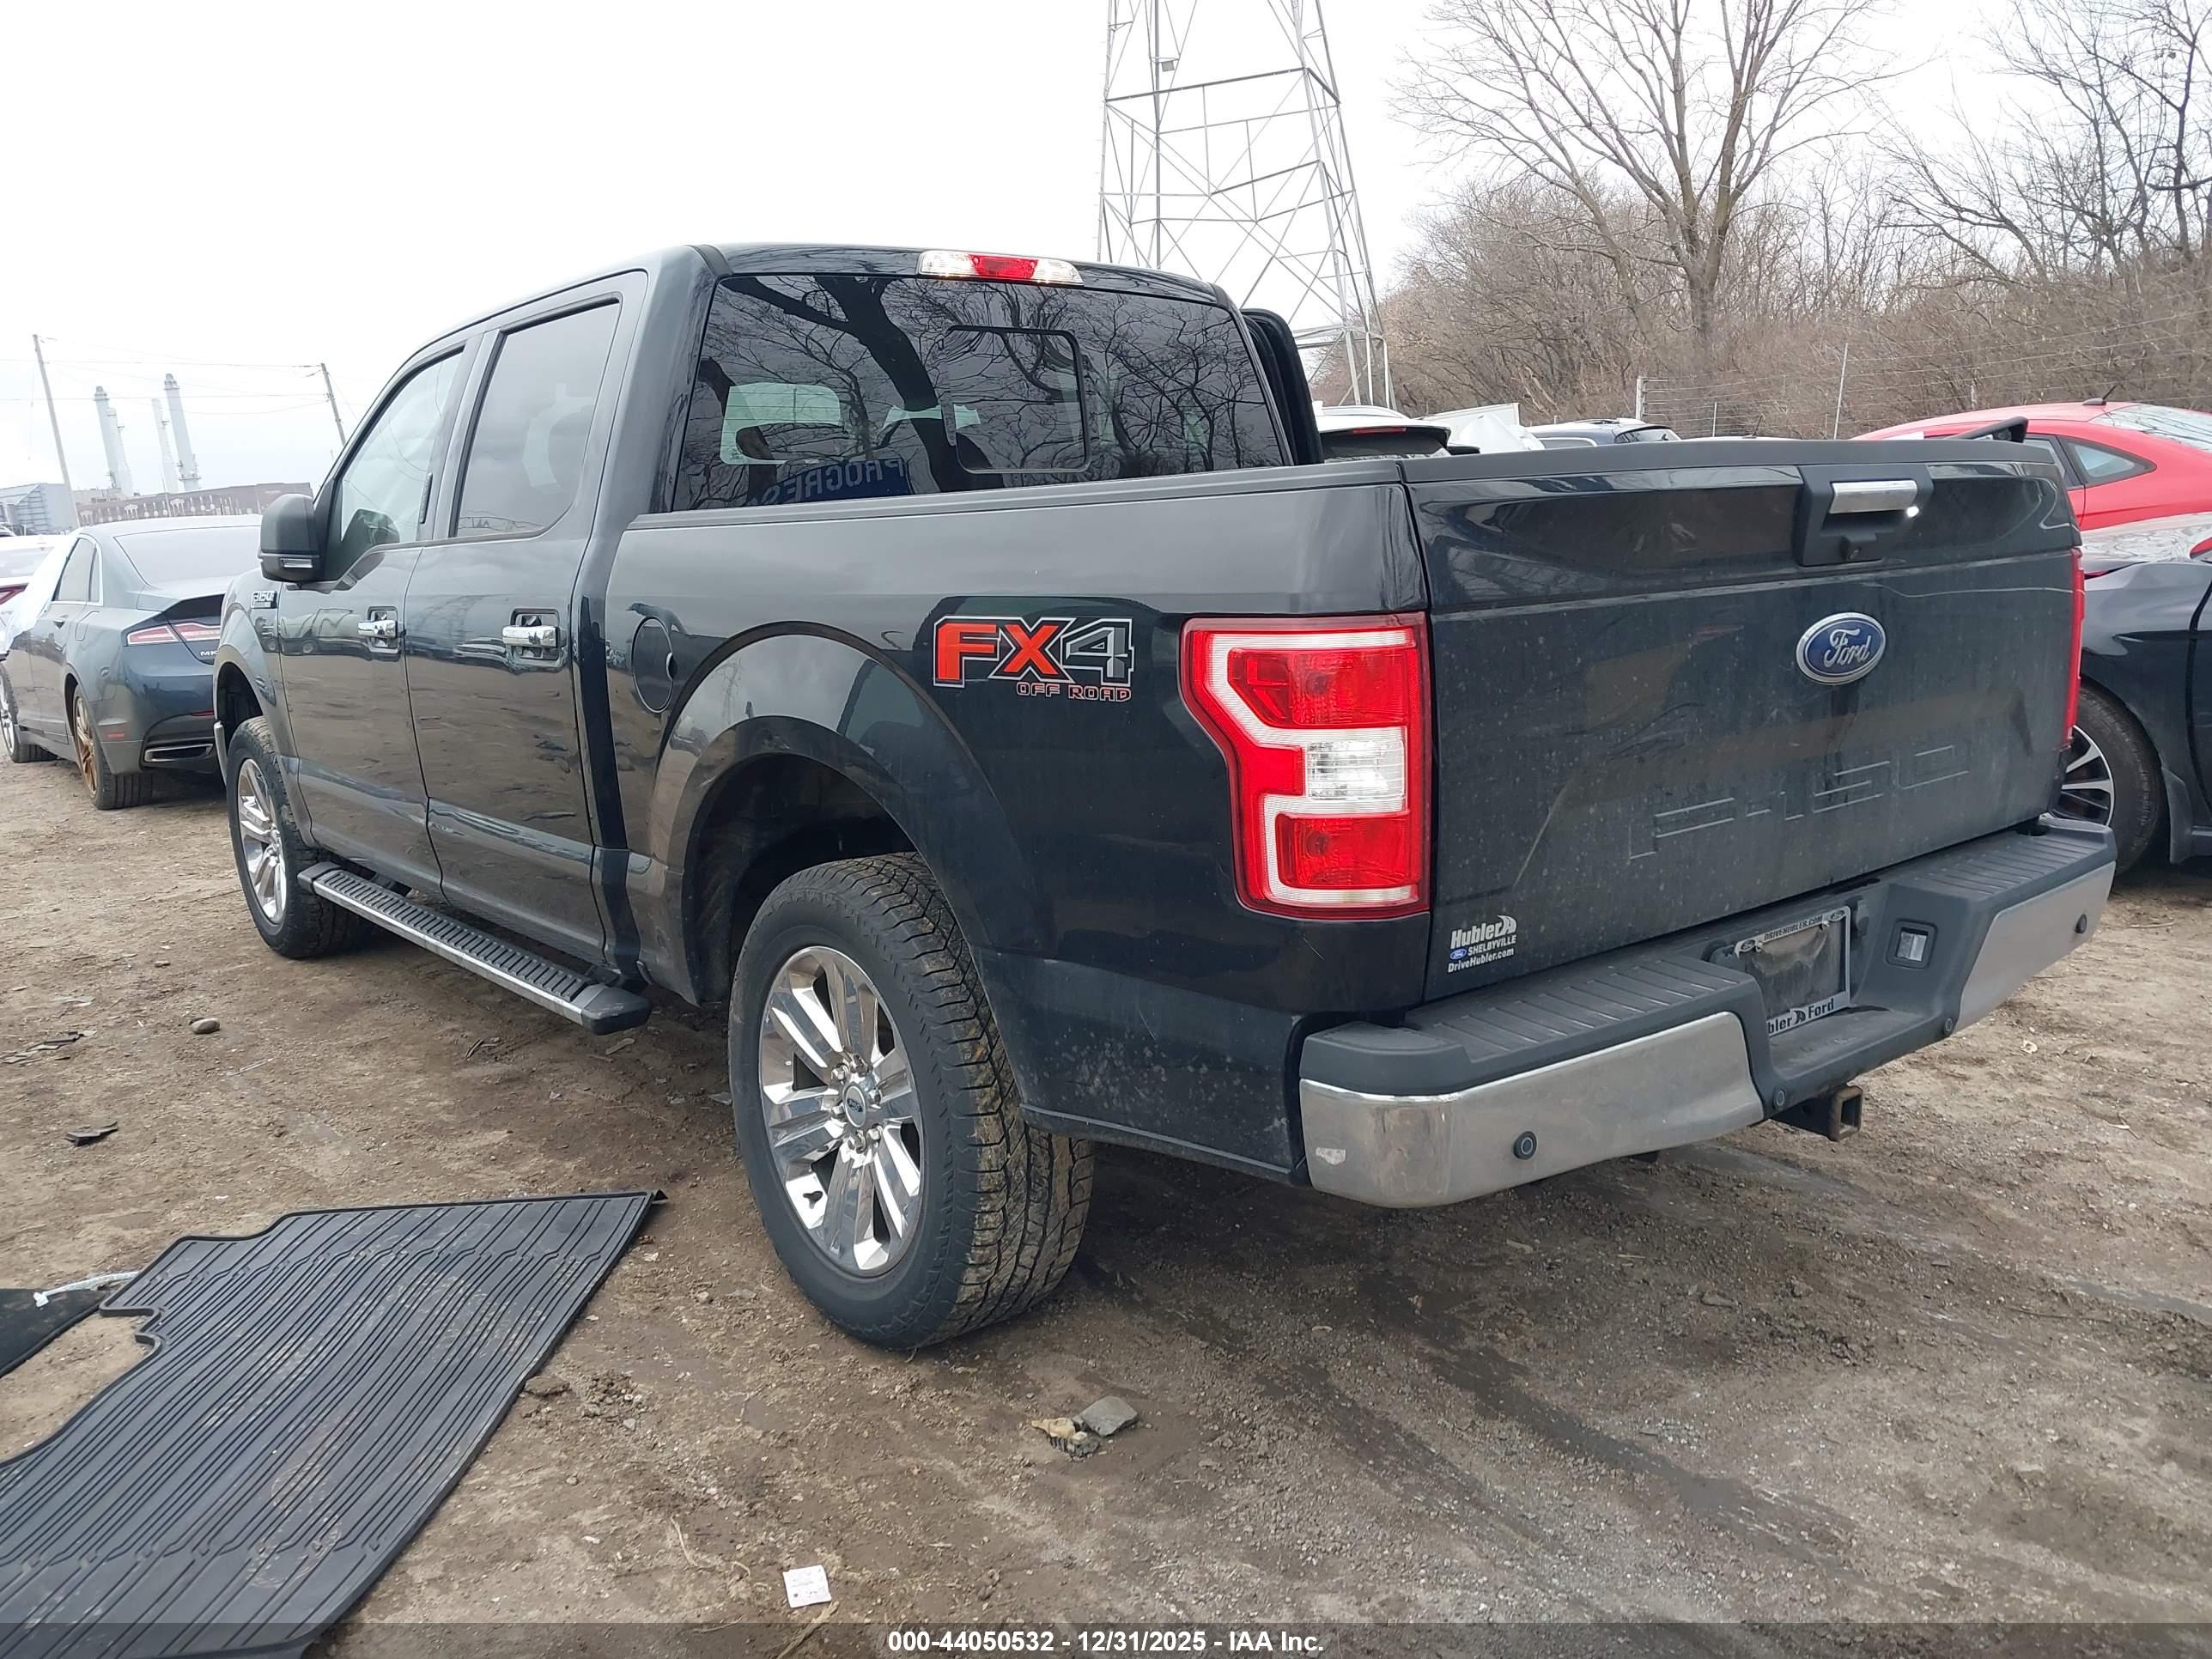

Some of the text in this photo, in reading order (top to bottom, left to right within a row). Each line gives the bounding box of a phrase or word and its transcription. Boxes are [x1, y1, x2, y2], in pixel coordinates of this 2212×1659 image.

[933, 616, 1134, 688] FX4
[1823, 628, 1872, 668] Ford
[1016, 681, 1132, 702] OFF ROAD
[1449, 921, 1503, 950] Hubler
[1467, 933, 1517, 957] SHELBYVILLE
[1447, 947, 1515, 974] DriveHubler.com
[1808, 997, 1835, 1019] Ford
